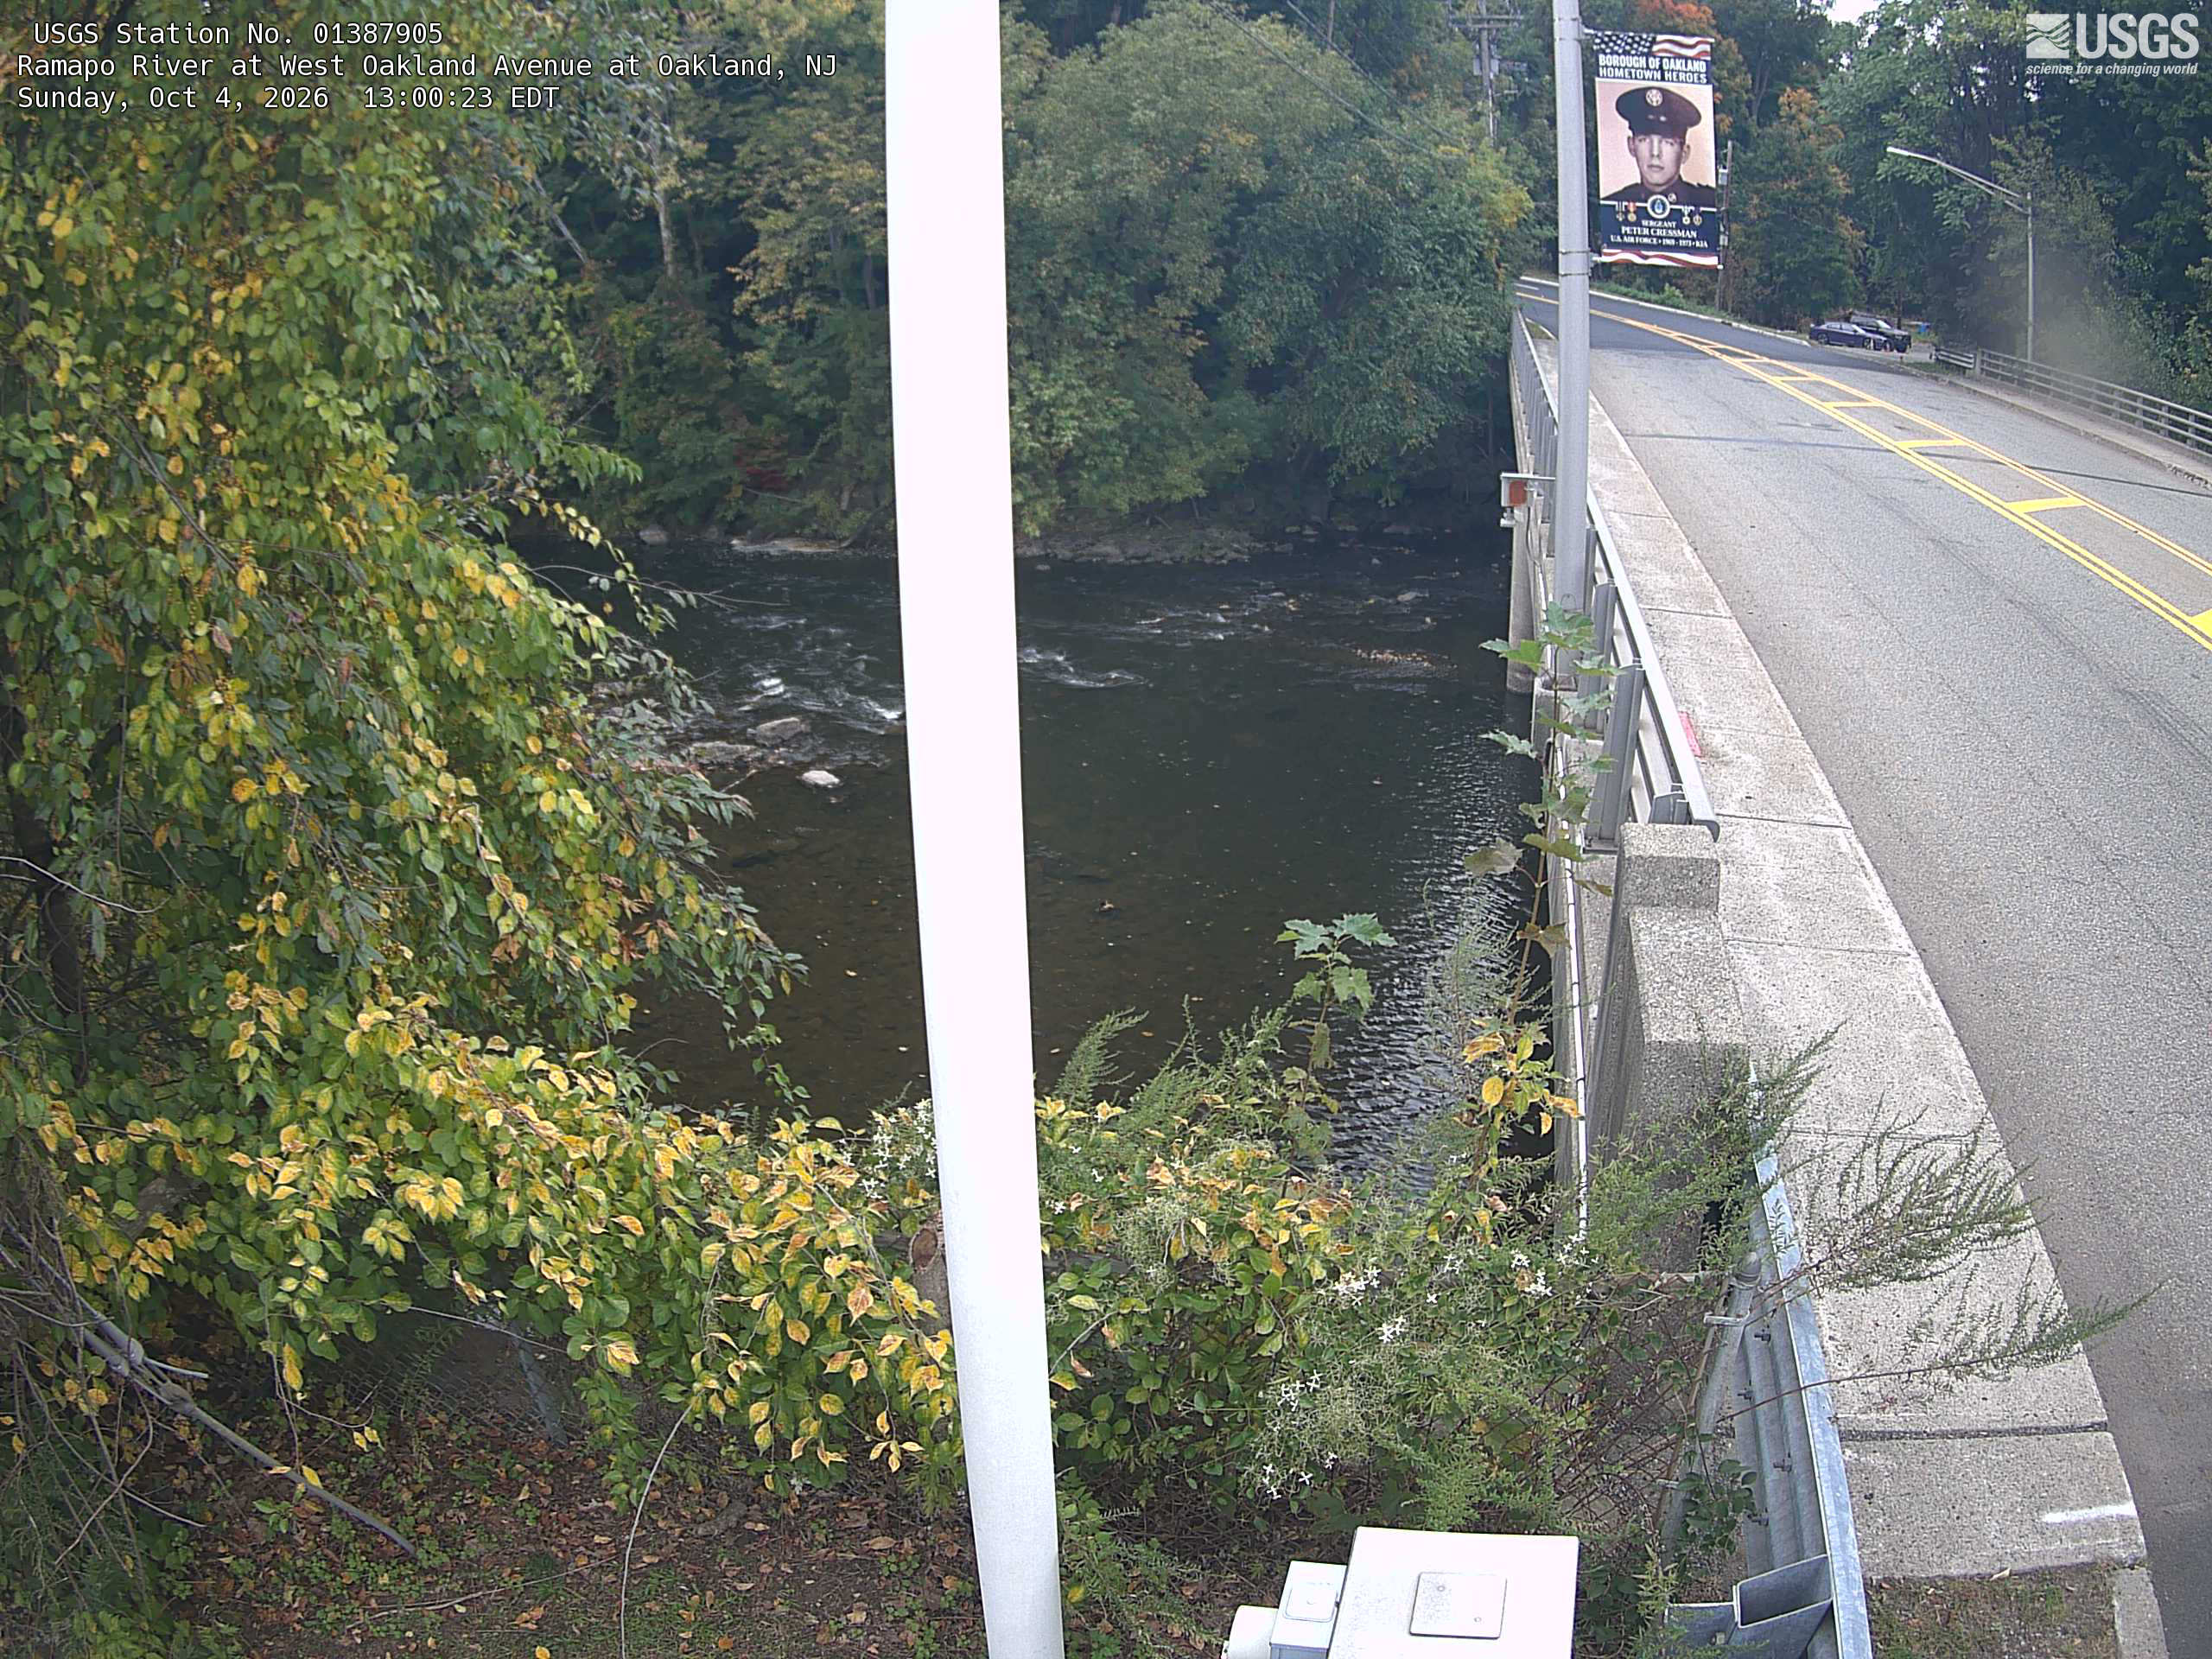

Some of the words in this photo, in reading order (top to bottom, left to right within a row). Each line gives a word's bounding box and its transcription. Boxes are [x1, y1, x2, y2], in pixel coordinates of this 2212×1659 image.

[1599, 54, 1646, 68] BOROUGH
[1648, 55, 1661, 69] OF
[1662, 58, 1707, 73] OAKLAND
[1599, 67, 1661, 80] HOMETOWN
[1664, 71, 1707, 84] HEROES
[1642, 219, 1676, 228] SERGEANT
[1621, 226, 1649, 235] PETER
[1650, 228, 1697, 238] CRESSMAN
